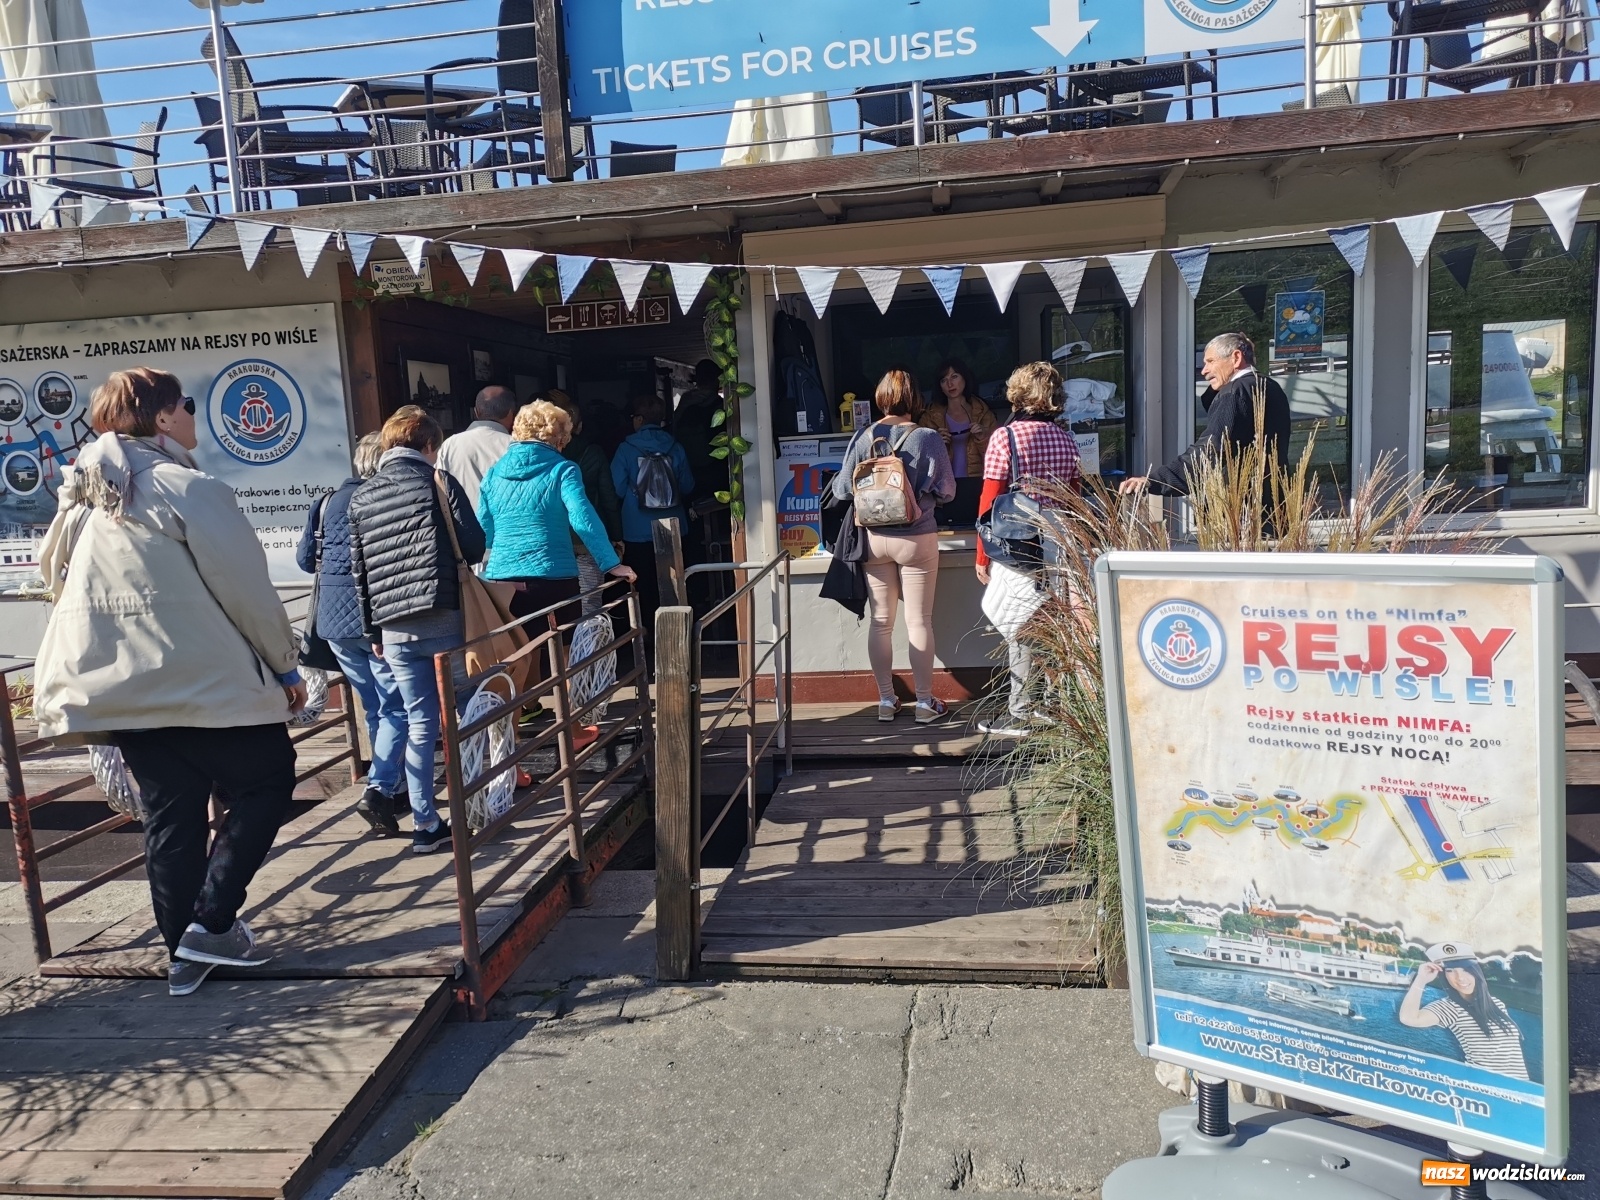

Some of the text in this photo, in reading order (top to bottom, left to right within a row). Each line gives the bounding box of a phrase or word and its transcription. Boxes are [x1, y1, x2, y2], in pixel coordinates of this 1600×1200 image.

[1214, 0, 1268, 27] PASAŻERS
[592, 26, 977, 94] TICKETS FOR CRUISES
[0, 345, 69, 363] SAŻERSKA
[84, 338, 177, 358] ZAPRASZAMY
[181, 336, 201, 351] NA
[204, 333, 247, 349] REJSY
[251, 332, 271, 346] PO
[274, 326, 318, 345] WIŚLE
[227, 364, 276, 380] KRAKOWSKA
[220, 431, 298, 461] ŻEGLUGA PASAŻERSKA
[282, 487, 286, 496] i
[288, 485, 302, 496] do
[303, 484, 335, 498] Tyńca
[786, 495, 820, 511] Kupi
[254, 524, 304, 534] niec river
[784, 513, 804, 522] REJSY
[272, 537, 293, 549] and
[1159, 605, 1200, 618] KRAKOWSKA
[1240, 605, 1308, 619] Cruises
[1316, 609, 1338, 620] on
[1346, 608, 1377, 621] the
[1242, 620, 1516, 679] REJSY
[1149, 658, 1216, 684] ŻEGLUGA PASAŻERSKA
[1242, 665, 1299, 693] PO
[1246, 704, 1472, 733] Rejsy statkiem NIMFA:
[1247, 721, 1320, 735] codziennie
[1325, 728, 1342, 737] od
[1347, 729, 1403, 743] godziny
[1445, 737, 1463, 747] do
[1248, 735, 1450, 764] dodatkowo REJSY NOCĄ!
[1370, 784, 1432, 798] PRZYSTANI
[1380, 776, 1467, 793] Statek odpływa
[1174, 1011, 1193, 1023] tel:
[1193, 1016, 1207, 1027] 12
[1208, 1018, 1228, 1031] 422
[1228, 1023, 1242, 1035] 08
[1260, 1031, 1282, 1044] 505
[1283, 1035, 1304, 1050] 102
[1330, 1048, 1369, 1066] e-mail:
[1247, 1015, 1269, 1027] Więcej
[1346, 1040, 1387, 1055] szczegółowe
[1387, 1050, 1407, 1060] mapy
[1200, 1031, 1491, 1118] www.StatekKrakow.com
